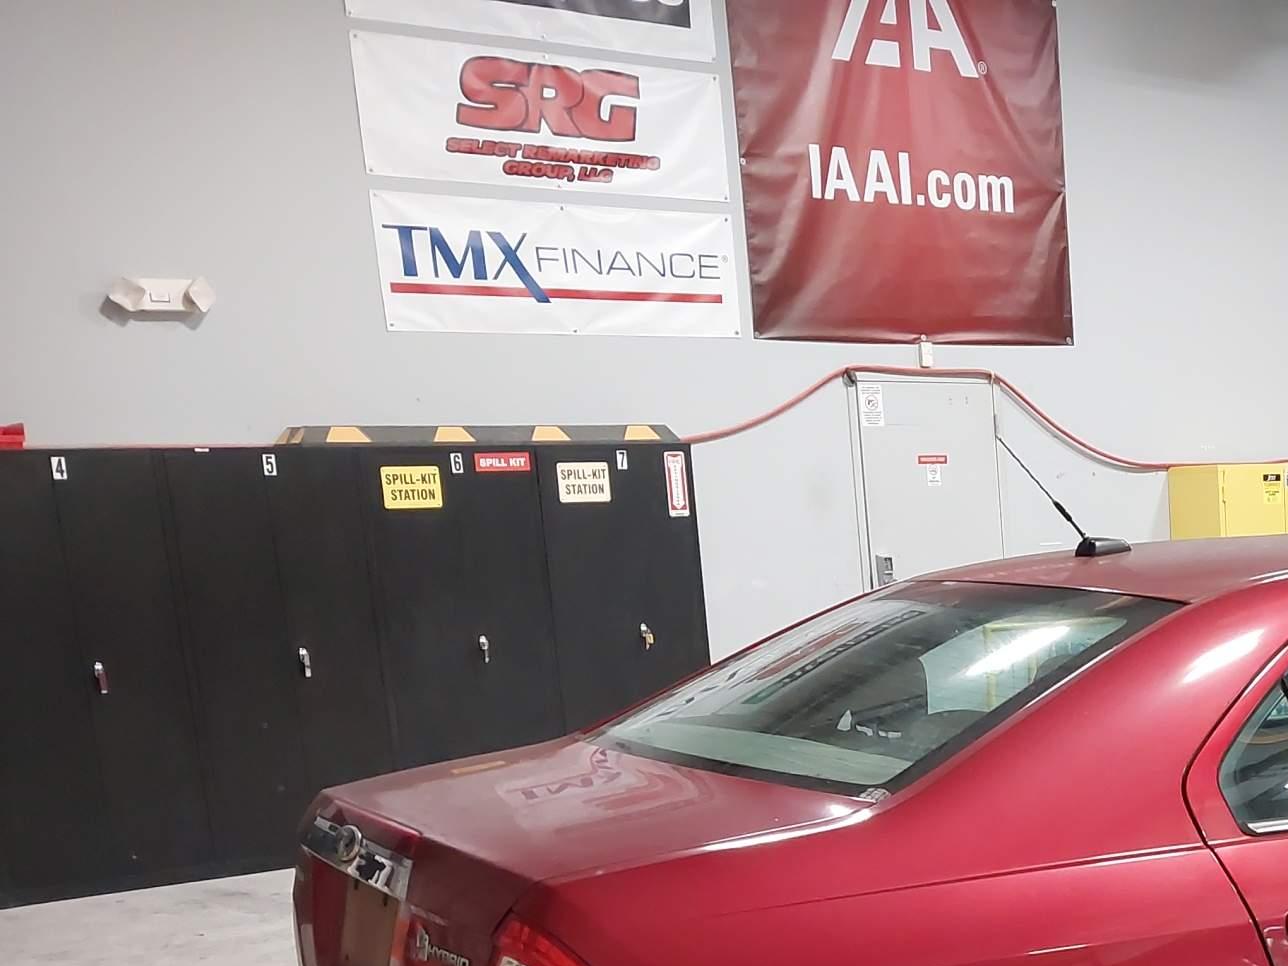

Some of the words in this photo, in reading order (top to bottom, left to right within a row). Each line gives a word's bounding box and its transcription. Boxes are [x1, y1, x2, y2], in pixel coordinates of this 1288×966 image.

[456, 55, 640, 142] SRG
[446, 137, 522, 158] SELECT
[521, 144, 661, 171] REMARKETING
[503, 160, 575, 182] GROUP,
[577, 166, 614, 183] LLC
[808, 143, 1015, 213] IAAI.com
[381, 223, 552, 303] TMX
[535, 246, 721, 279] FINANCE
[55, 458, 65, 479] 4
[265, 456, 274, 474] 5
[453, 454, 461, 472] 6
[480, 457, 507, 468] SPILL
[509, 457, 526, 467] KIT
[618, 452, 625, 468] 7
[385, 473, 437, 485] SPILL-KIT
[560, 469, 606, 480] SPILL-KIT
[391, 489, 436, 501] STATION
[565, 483, 605, 495] STATION
